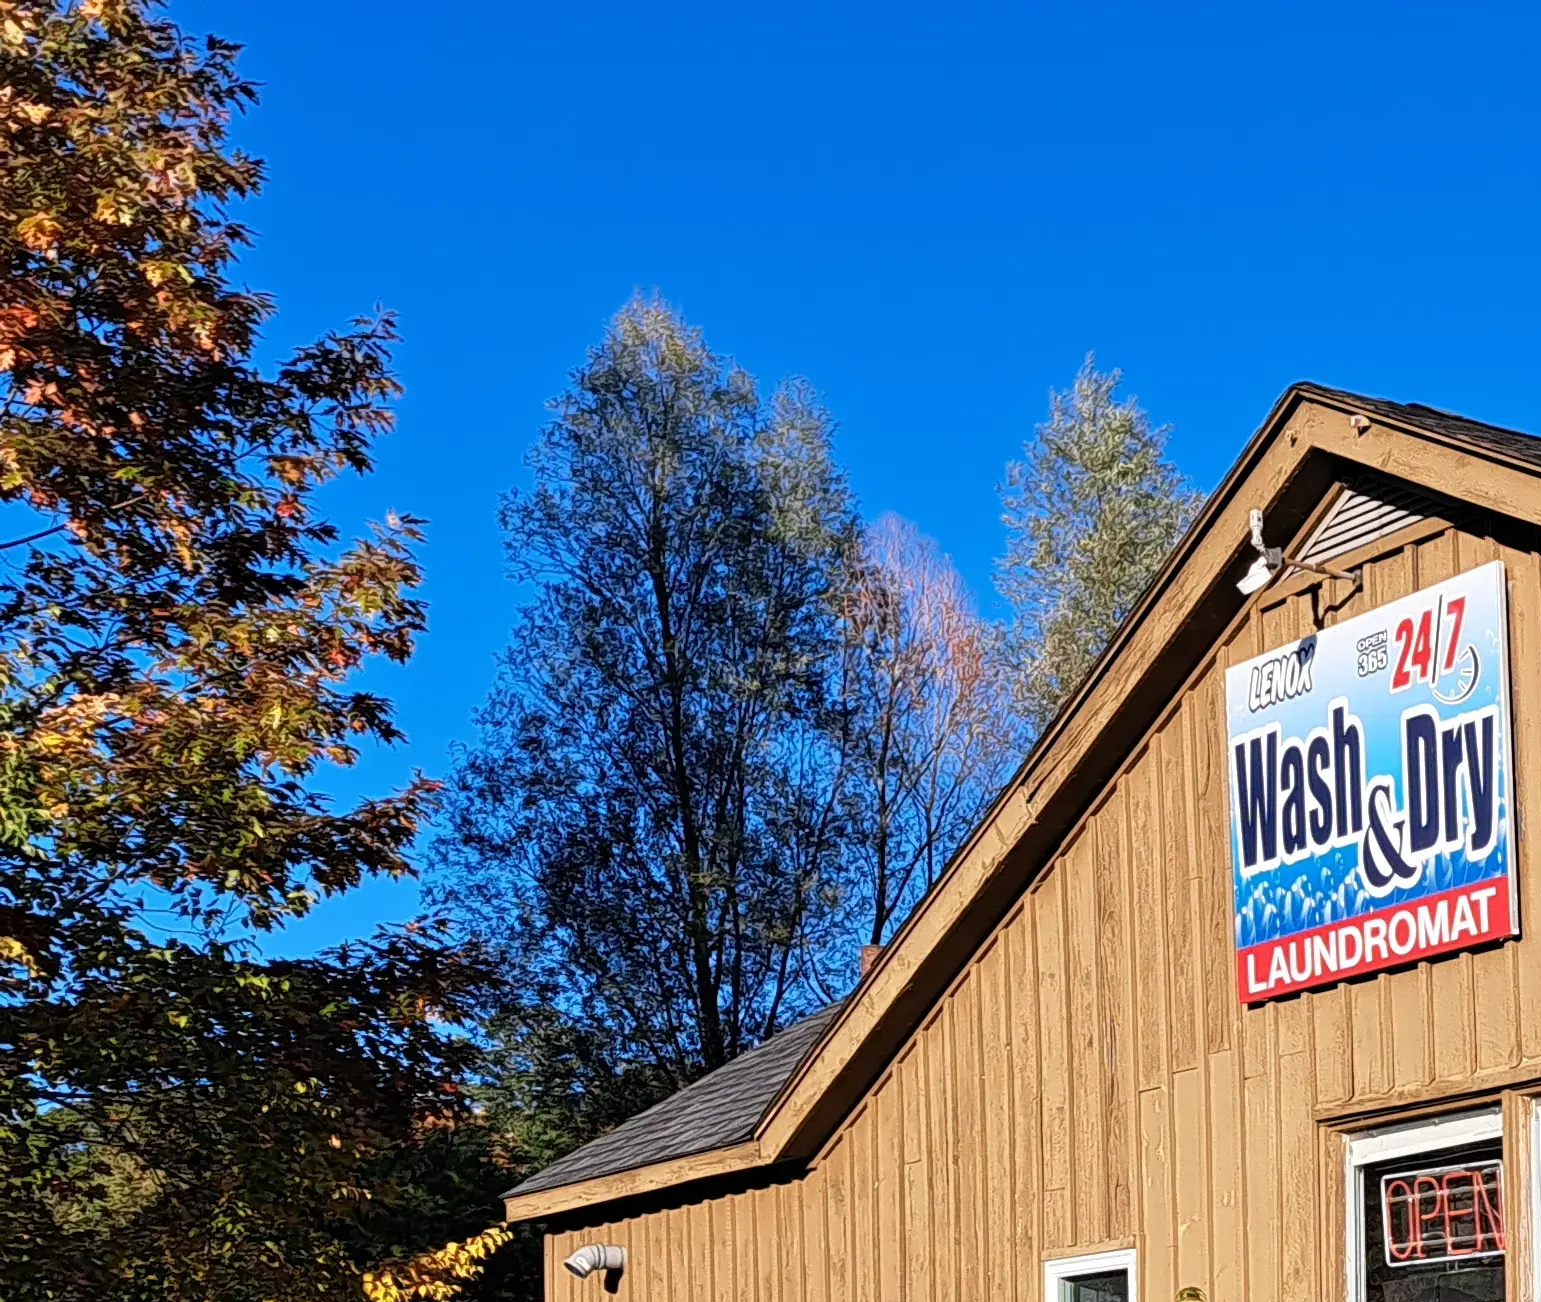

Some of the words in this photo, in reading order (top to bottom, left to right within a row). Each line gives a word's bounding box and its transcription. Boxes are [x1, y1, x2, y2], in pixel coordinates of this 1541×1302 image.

[1249, 643, 1316, 713] LENOX
[1356, 629, 1389, 653] OPEN
[1357, 646, 1389, 678] 365
[1392, 594, 1466, 690] 24/7
[1235, 704, 1363, 869] Wash
[1363, 785, 1417, 889] &
[1406, 712, 1496, 852] Dry
[1247, 887, 1497, 995] LAUNDROMAT
[1386, 1170, 1506, 1260] OPEN
